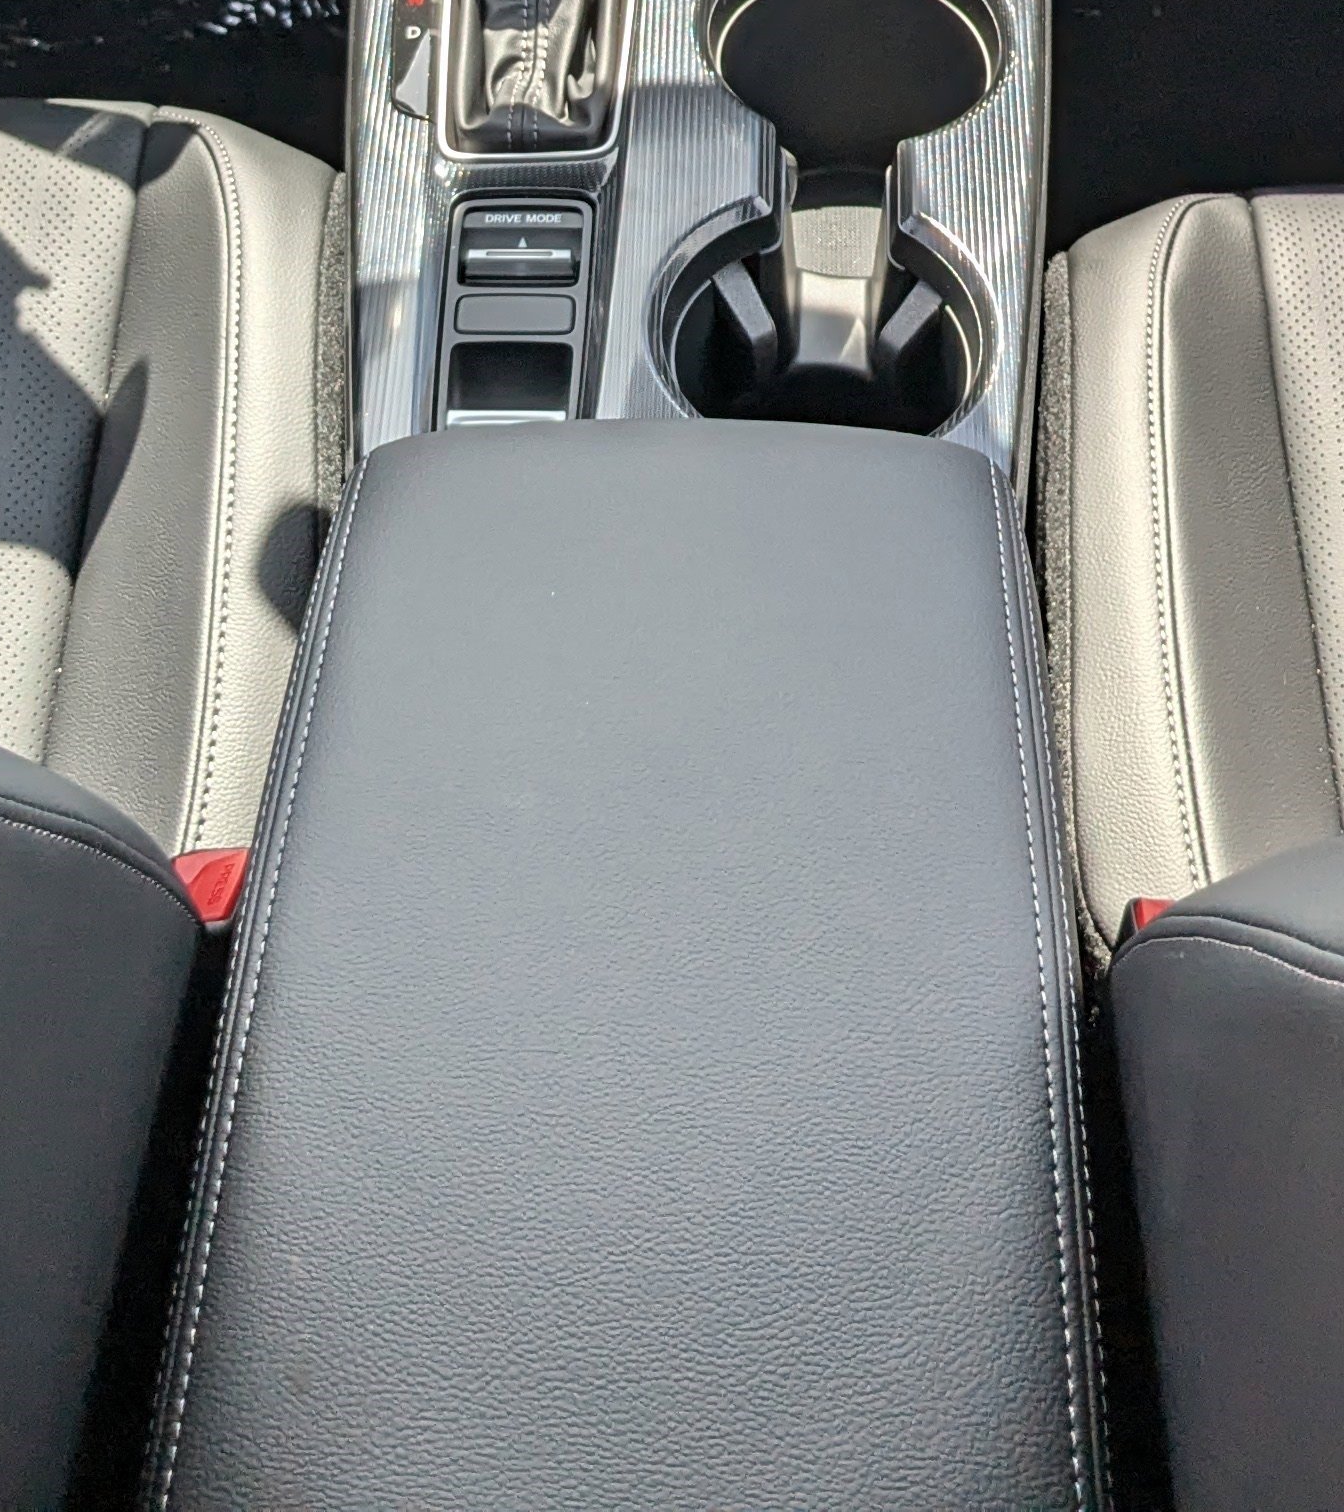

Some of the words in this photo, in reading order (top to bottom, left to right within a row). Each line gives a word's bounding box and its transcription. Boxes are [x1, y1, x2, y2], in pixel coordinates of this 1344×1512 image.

[406, 26, 421, 39] D
[485, 213, 522, 223] DRIVE
[525, 213, 563, 223] MODE
